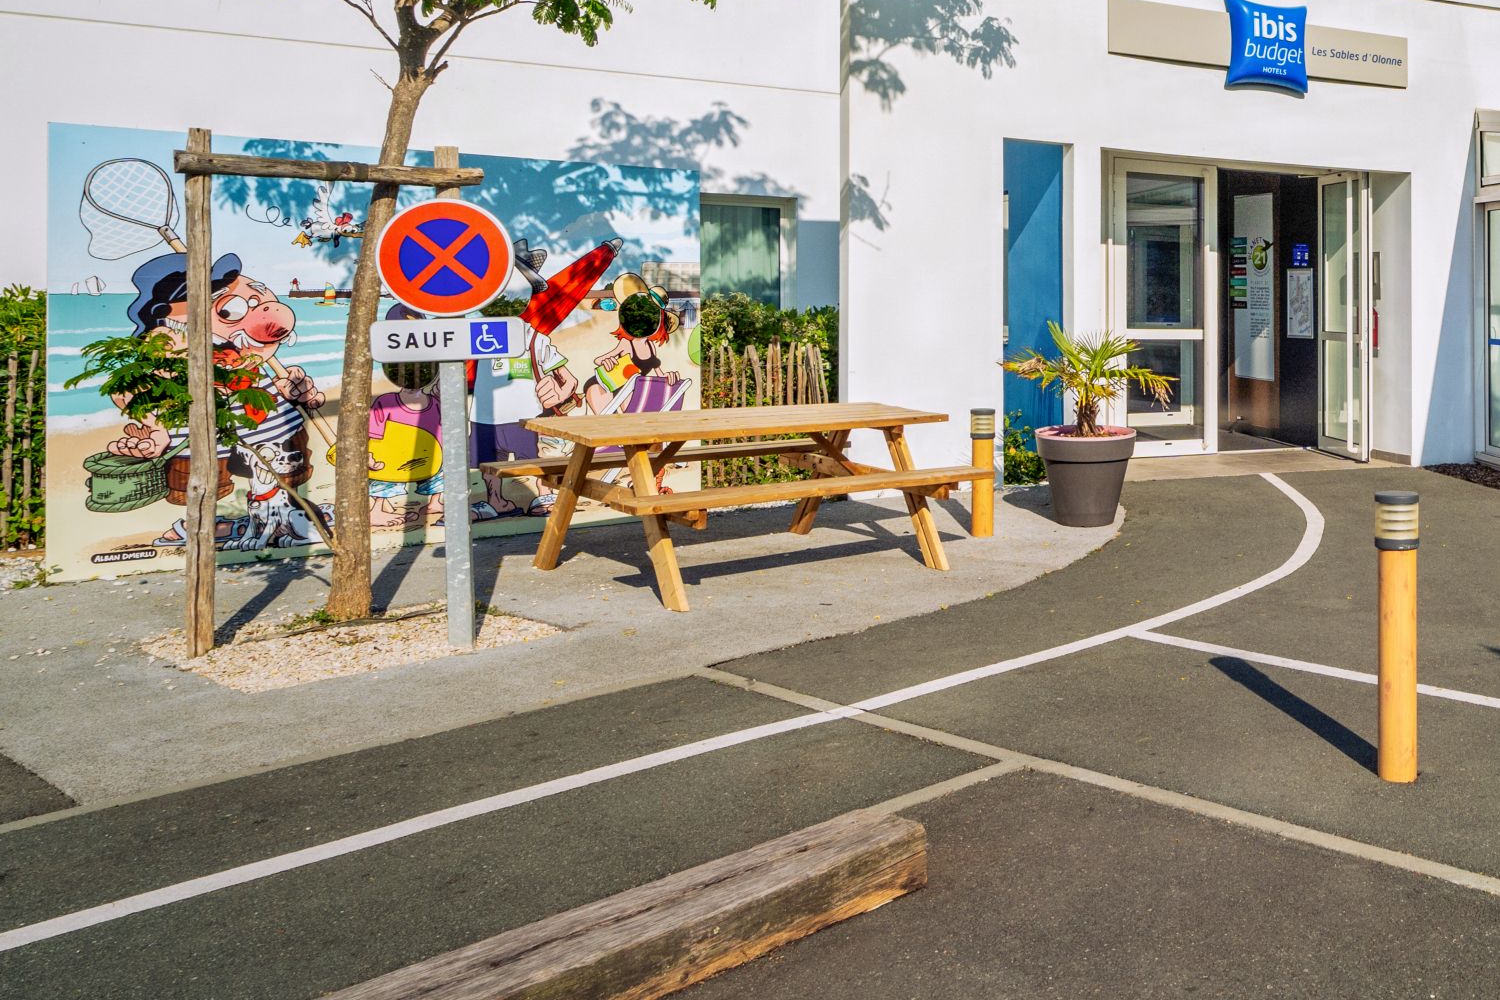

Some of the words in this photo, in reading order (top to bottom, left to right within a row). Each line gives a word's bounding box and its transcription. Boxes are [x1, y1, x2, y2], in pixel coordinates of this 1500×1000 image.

[1253, 11, 1297, 42] ibis
[1244, 39, 1303, 65] budget
[1311, 46, 1327, 57] Les
[1329, 49, 1360, 62] Sables
[1262, 66, 1287, 76] HOTELS
[1254, 251, 1266, 265] 21
[387, 331, 455, 350] SAUF
[94, 553, 121, 563] ALBAN
